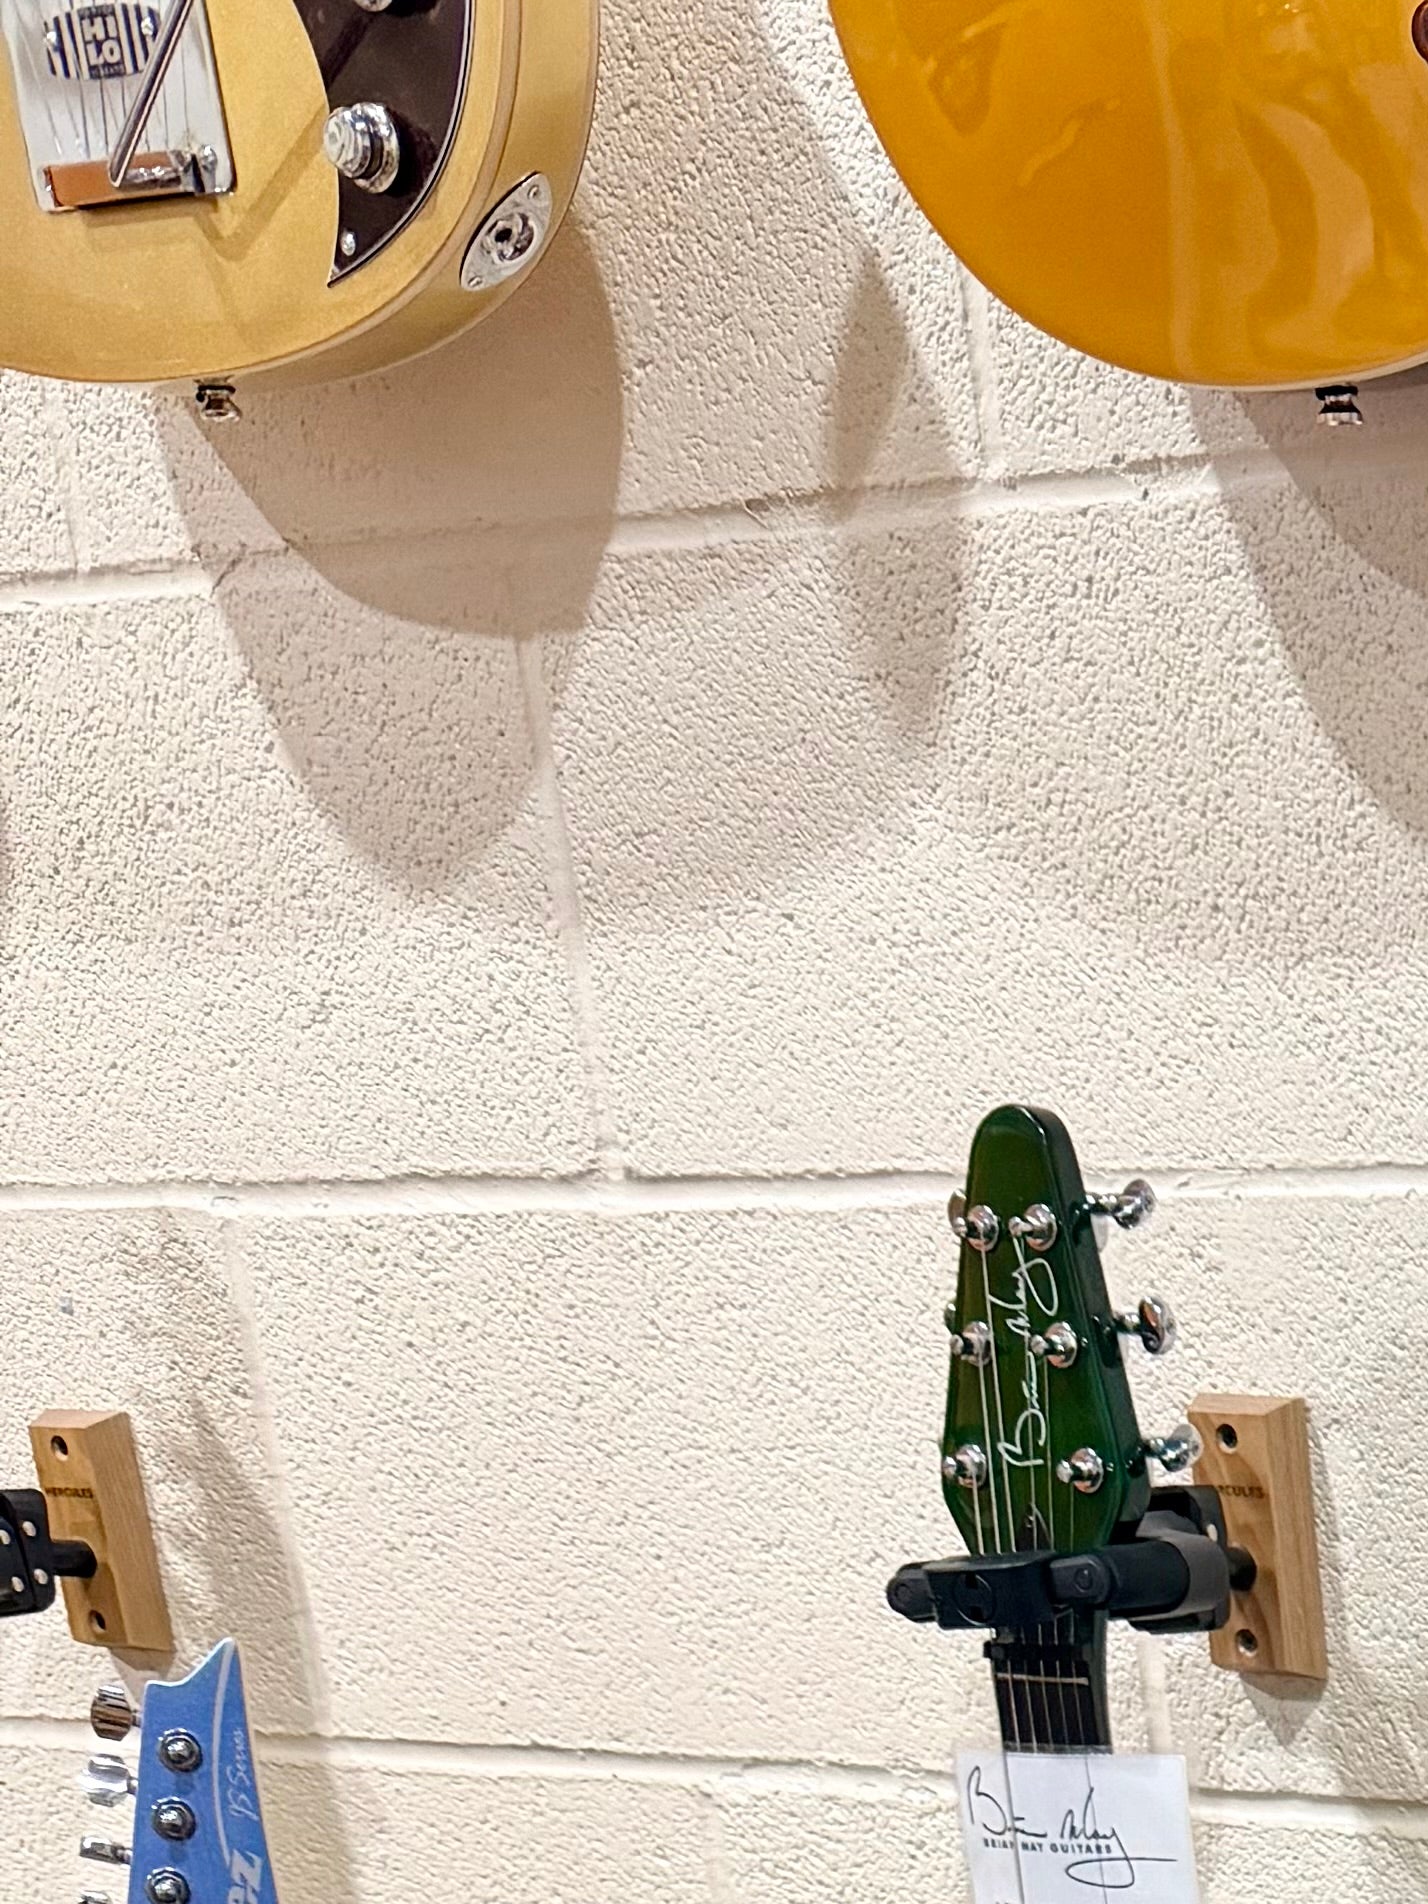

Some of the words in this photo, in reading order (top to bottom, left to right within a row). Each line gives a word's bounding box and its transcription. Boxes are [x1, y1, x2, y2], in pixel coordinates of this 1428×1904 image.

[81, 15, 118, 41] HI
[86, 39, 122, 66] LO
[1050, 1842, 1112, 1854] GUITARS
